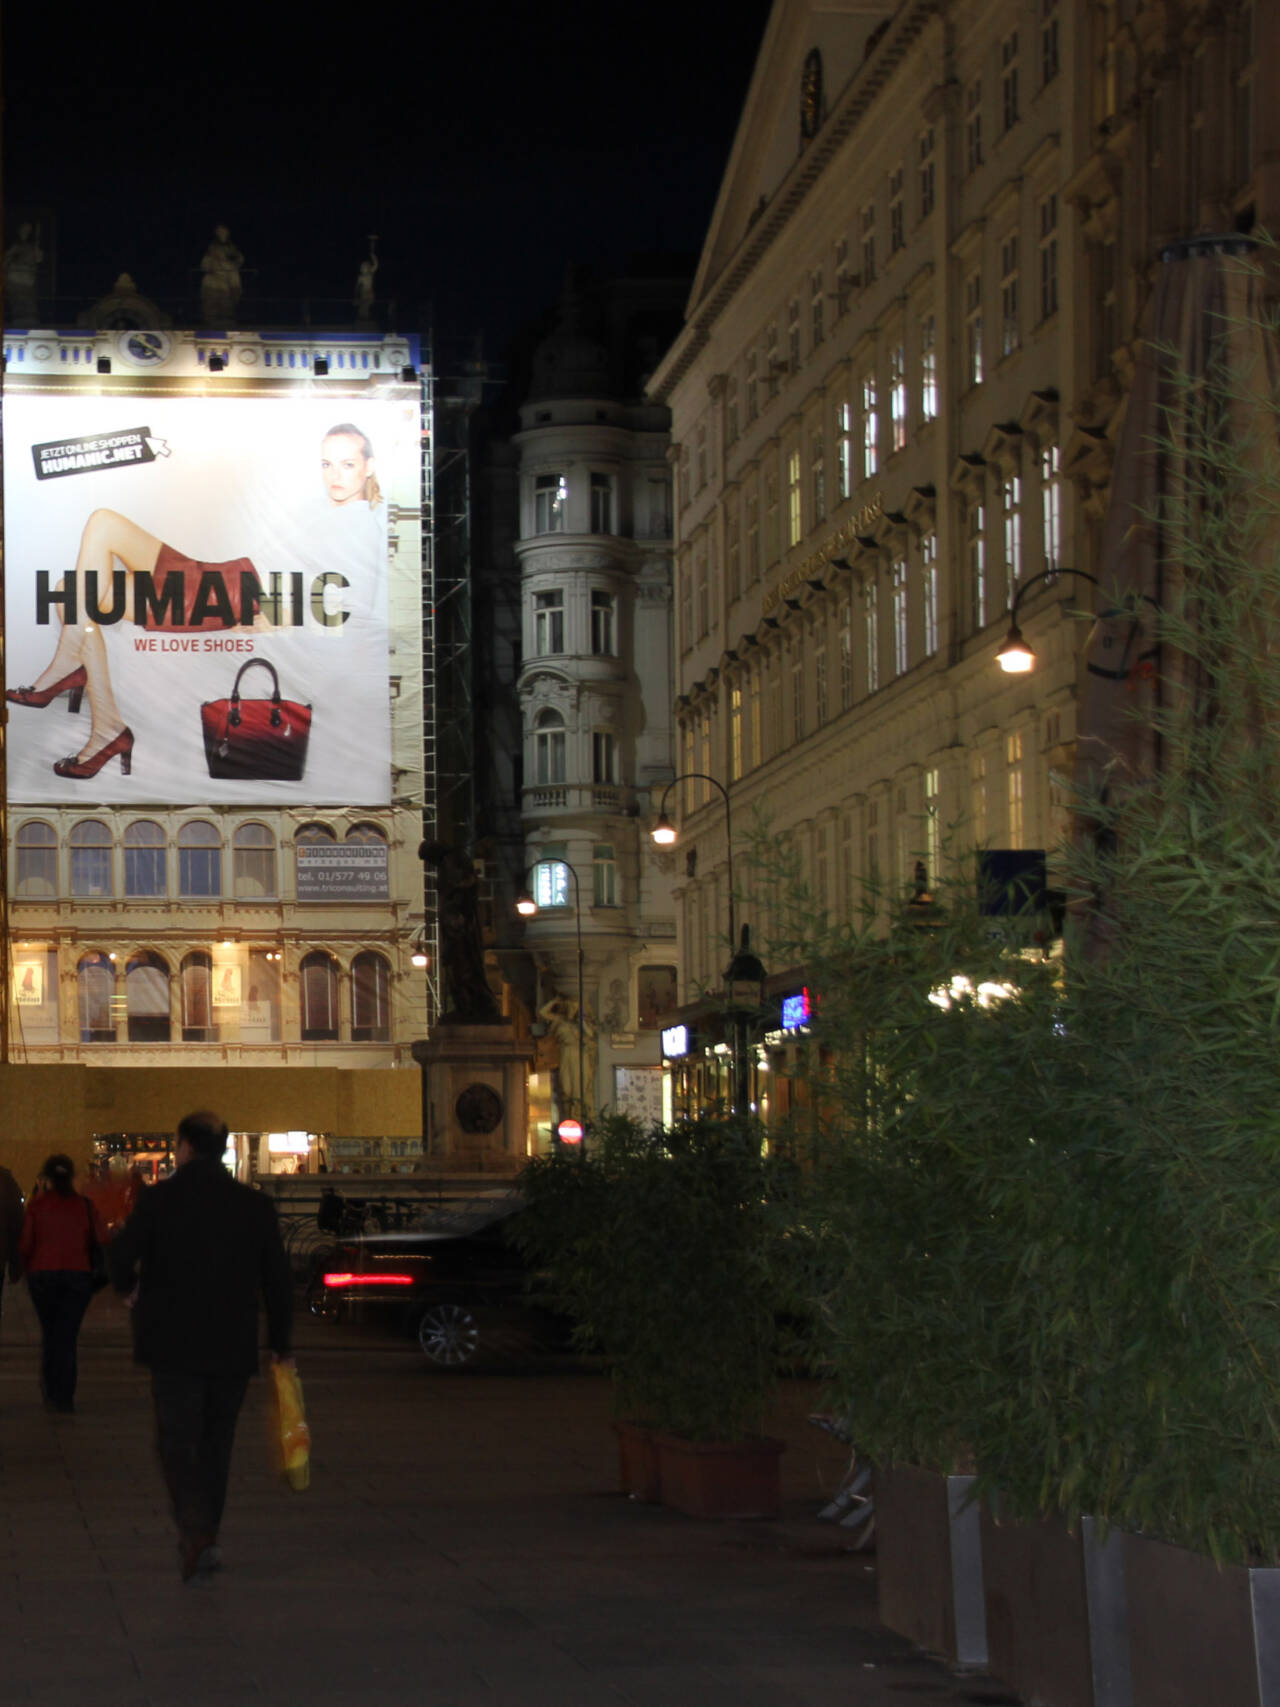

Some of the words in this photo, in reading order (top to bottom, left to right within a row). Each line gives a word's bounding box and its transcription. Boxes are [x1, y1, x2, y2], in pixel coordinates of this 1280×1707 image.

[40, 446, 65, 459] JETZT
[65, 440, 100, 455] ONLINE
[100, 434, 142, 450] SHOPPEN
[41, 445, 143, 474] HUMANIC.NET
[36, 569, 351, 627] HUMANIC
[134, 639, 157, 652] WE
[161, 639, 200, 652] LOVE
[204, 639, 254, 652] SHOES
[298, 871, 314, 881] tel.
